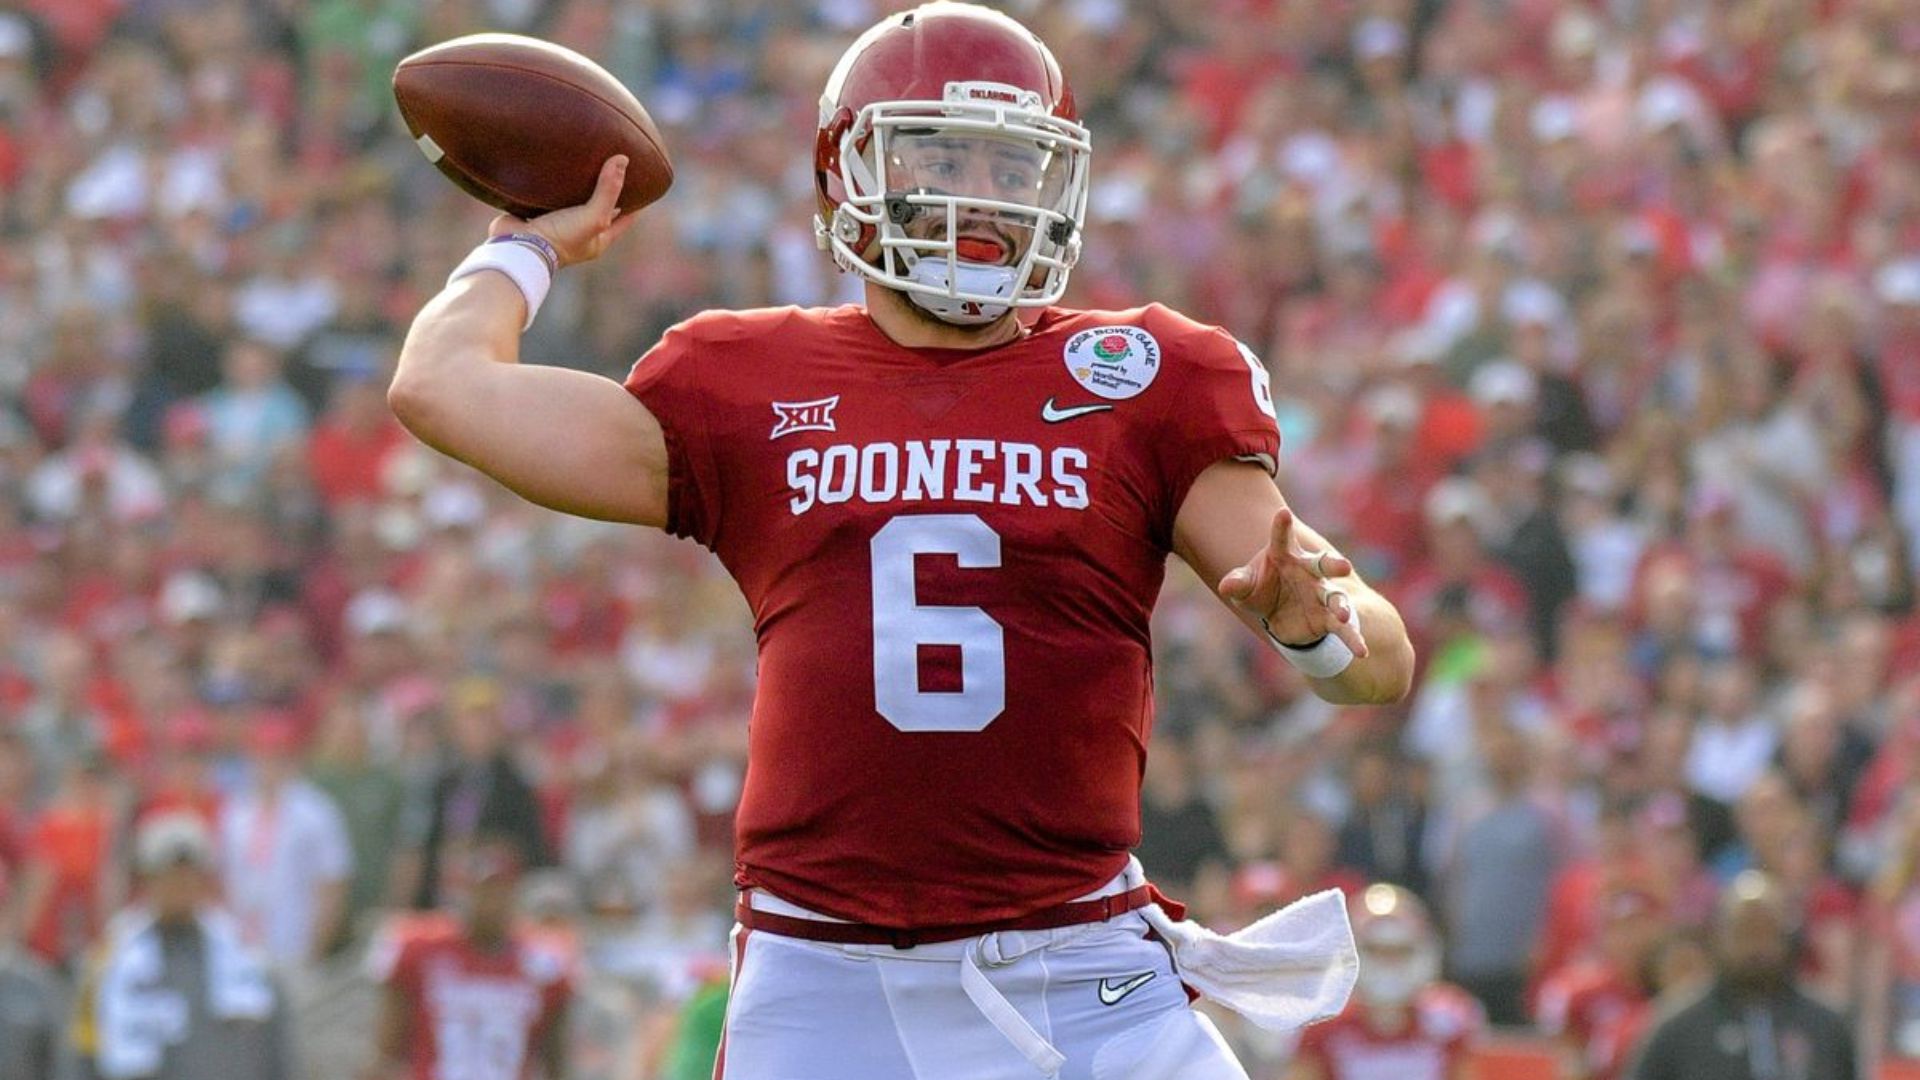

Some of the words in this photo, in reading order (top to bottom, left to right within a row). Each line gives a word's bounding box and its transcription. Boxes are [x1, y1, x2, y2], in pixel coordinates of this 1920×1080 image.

[969, 89, 1017, 104] OKLAHOMA
[1068, 332, 1094, 354] ROSE
[1094, 328, 1134, 337] BOWL
[1135, 333, 1156, 367] GAME
[786, 439, 1090, 516] SOONERS
[870, 513, 1006, 733] 6
